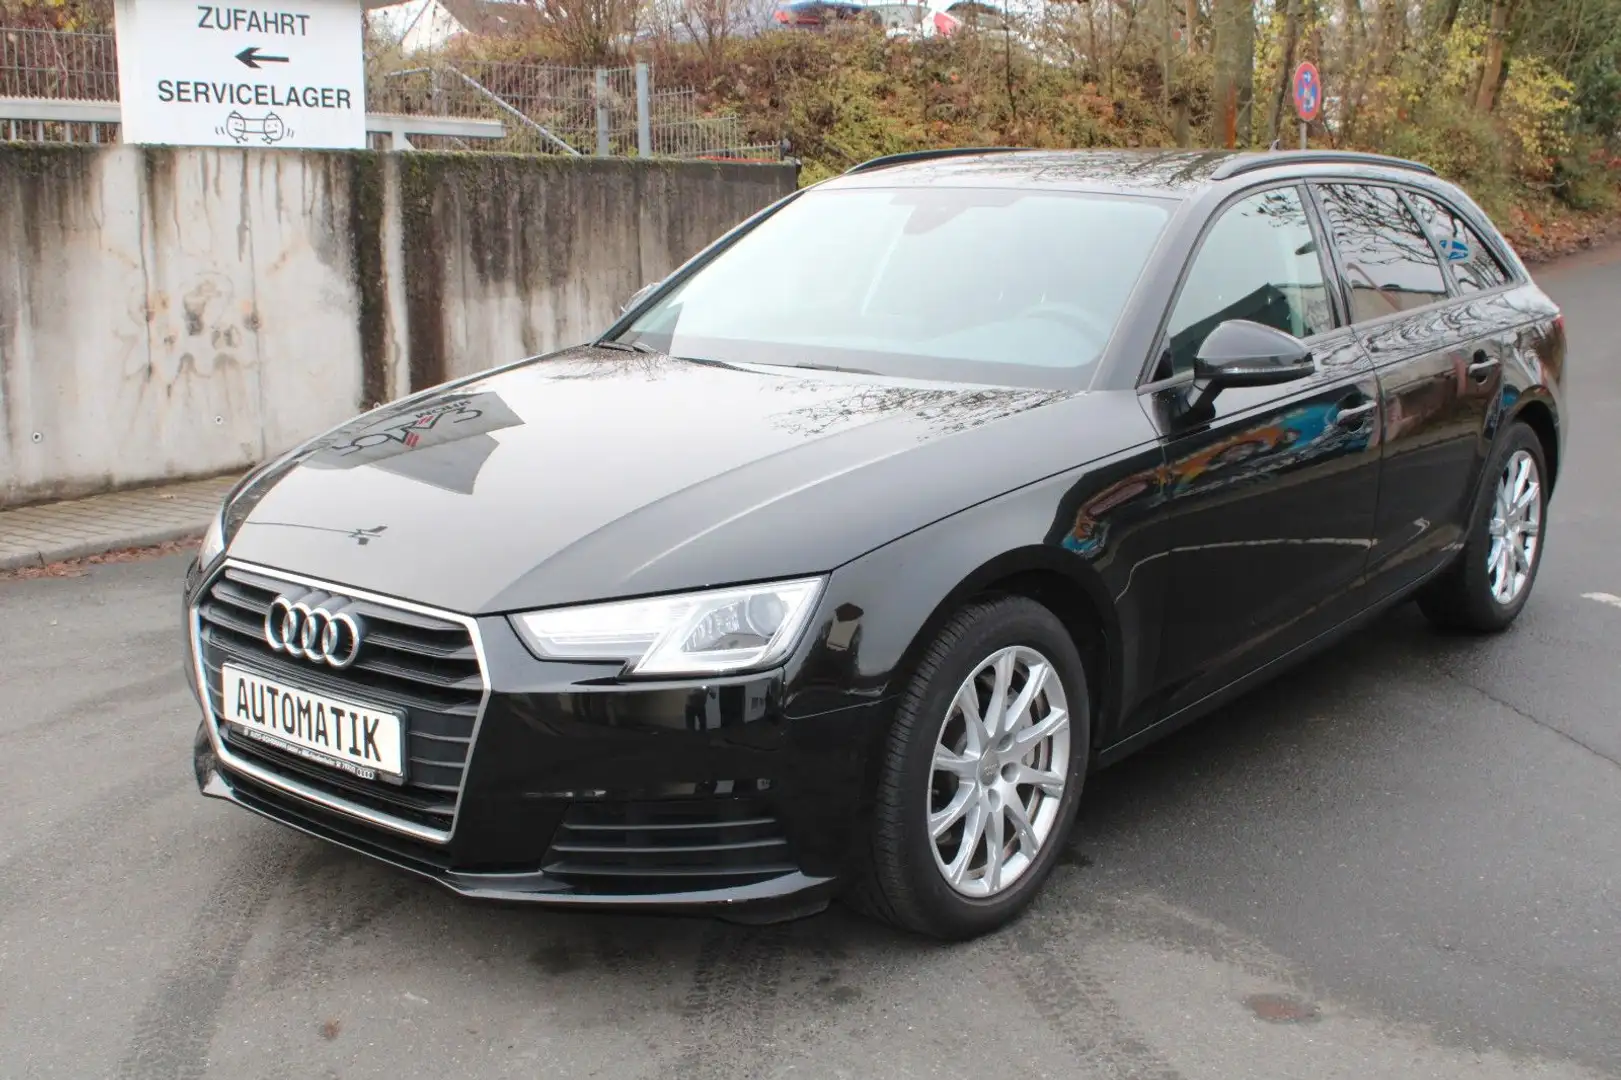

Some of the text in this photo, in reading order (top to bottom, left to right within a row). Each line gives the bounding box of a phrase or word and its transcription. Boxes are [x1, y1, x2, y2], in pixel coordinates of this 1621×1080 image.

[198, 6, 310, 36] ZUFAHRT
[158, 79, 352, 109] SERVICELAGER
[237, 677, 382, 762] AUTOMATIK
